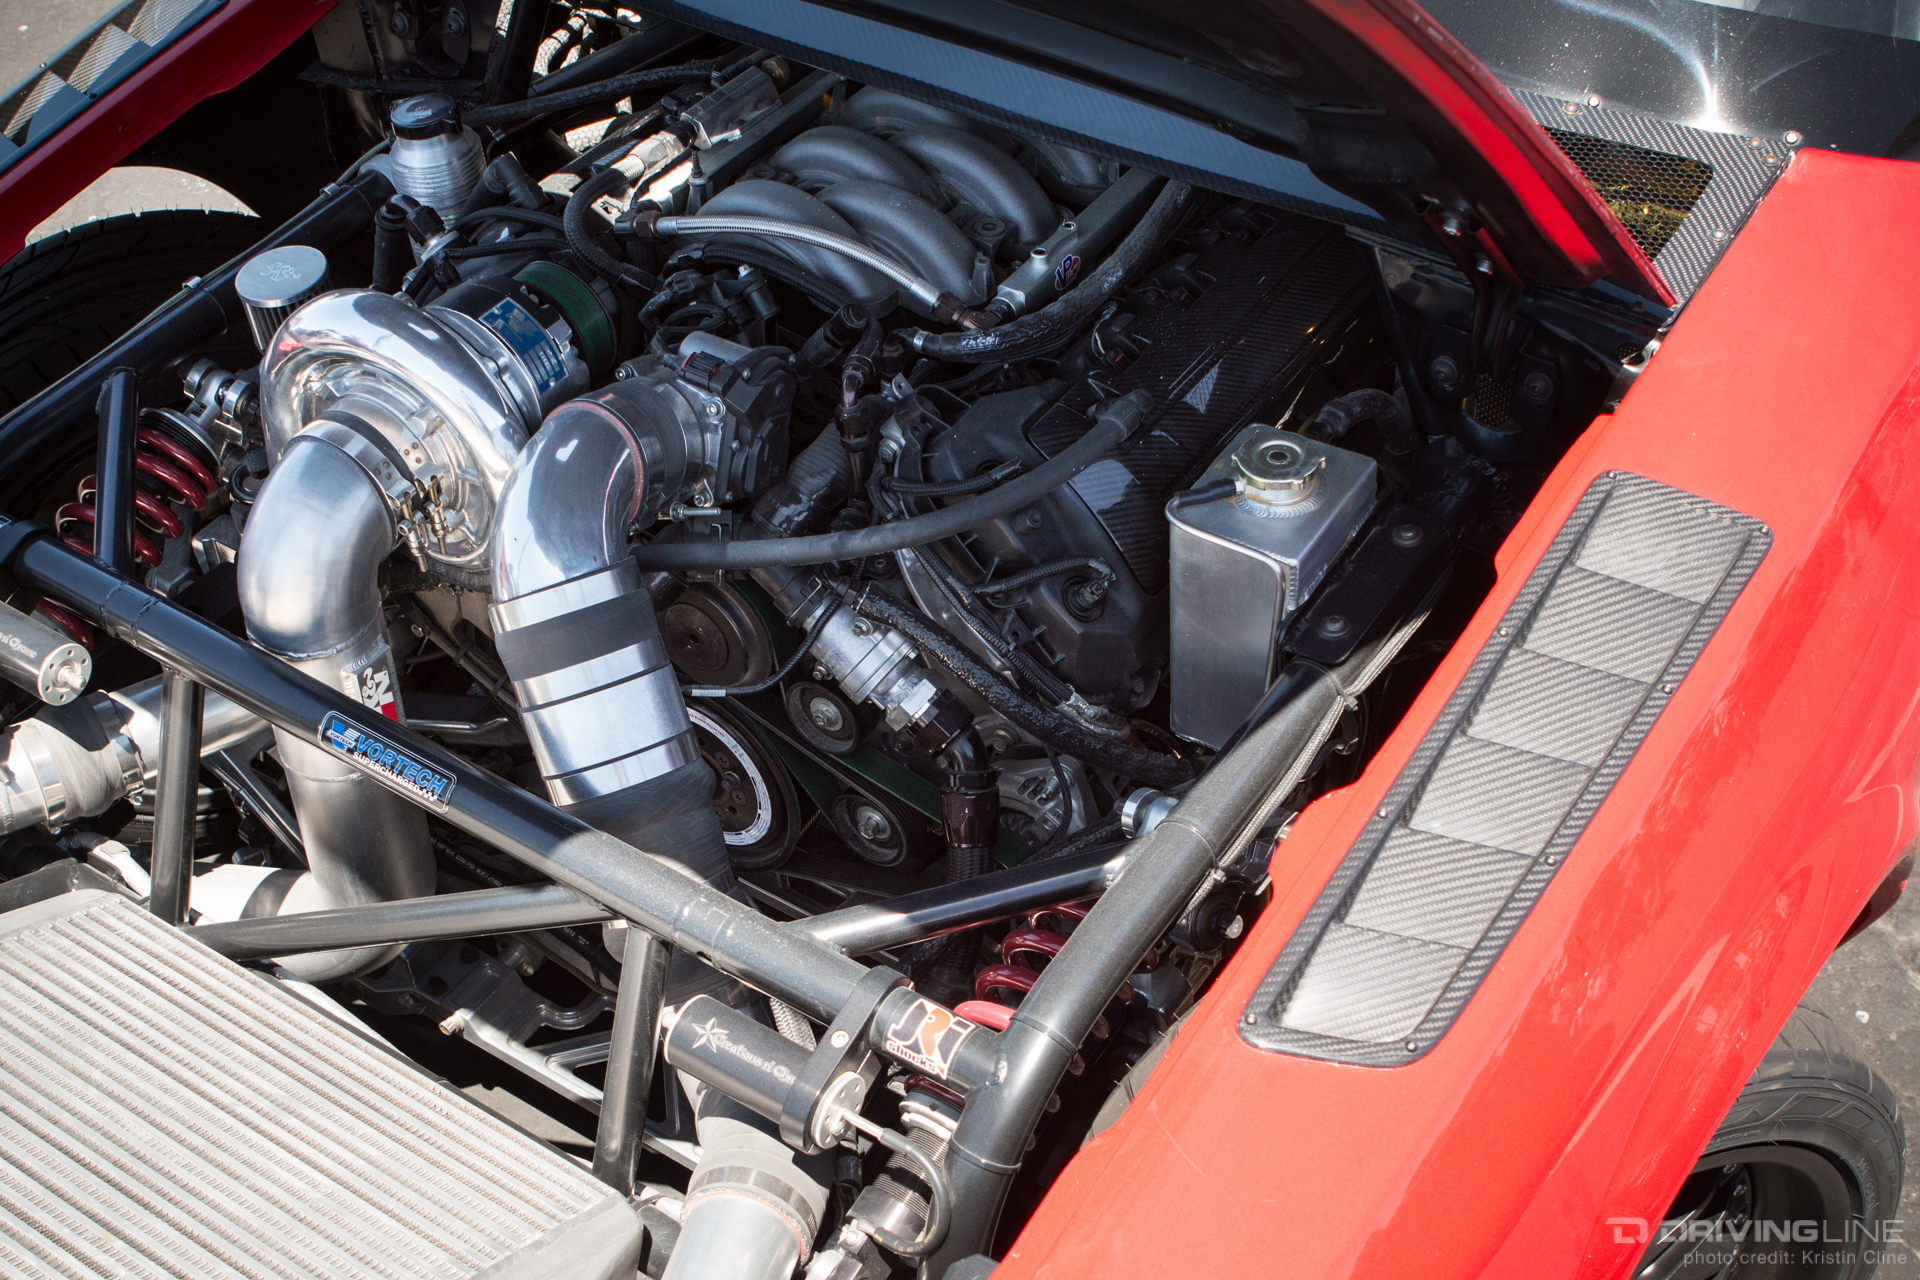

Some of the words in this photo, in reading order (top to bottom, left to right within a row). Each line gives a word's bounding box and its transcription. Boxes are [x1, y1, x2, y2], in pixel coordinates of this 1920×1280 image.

[260, 262, 301, 281] K&N
[327, 729, 357, 748] VORTECH
[351, 751, 424, 795] SUPERCHARGED
[357, 735, 448, 796] VORTECH
[714, 1033, 764, 1069] Creations
[886, 1040, 938, 1074] shocks
